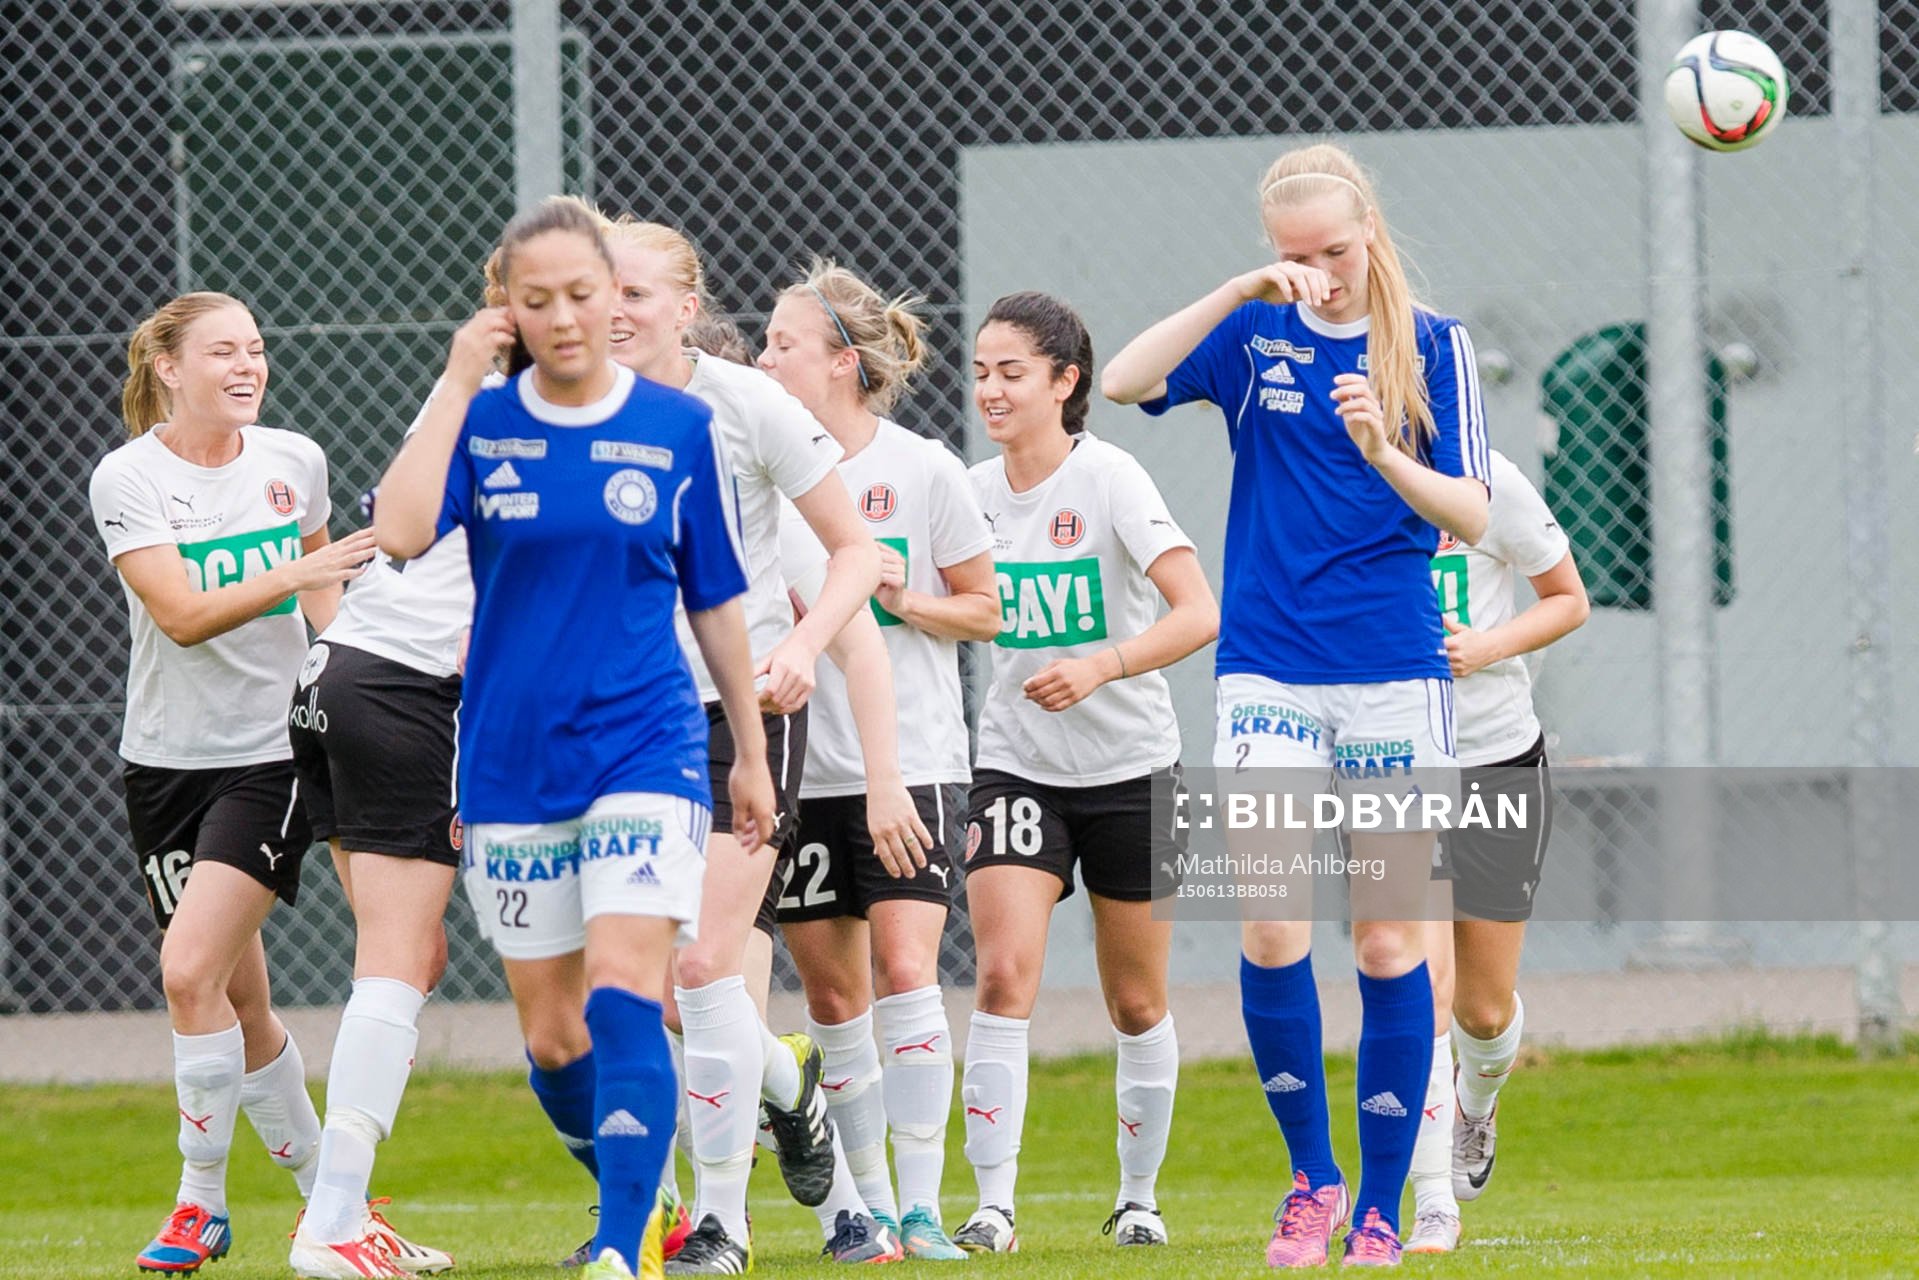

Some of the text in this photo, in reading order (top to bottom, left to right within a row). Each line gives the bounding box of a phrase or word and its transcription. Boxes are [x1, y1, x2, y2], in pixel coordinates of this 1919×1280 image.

[1268, 387, 1304, 403] INTER
[996, 572, 1095, 638] CAY!
[290, 686, 328, 733] kollo
[1231, 717, 1320, 750] KRAFT
[1335, 739, 1414, 759] RESUNDS
[1234, 742, 1251, 774] 2
[581, 817, 662, 838] RESUNDS
[984, 796, 1043, 856] 18
[145, 849, 192, 915] 16
[486, 852, 580, 882] KRAFT
[497, 888, 530, 928] 22
[1361, 1101, 1408, 1117] adidas
